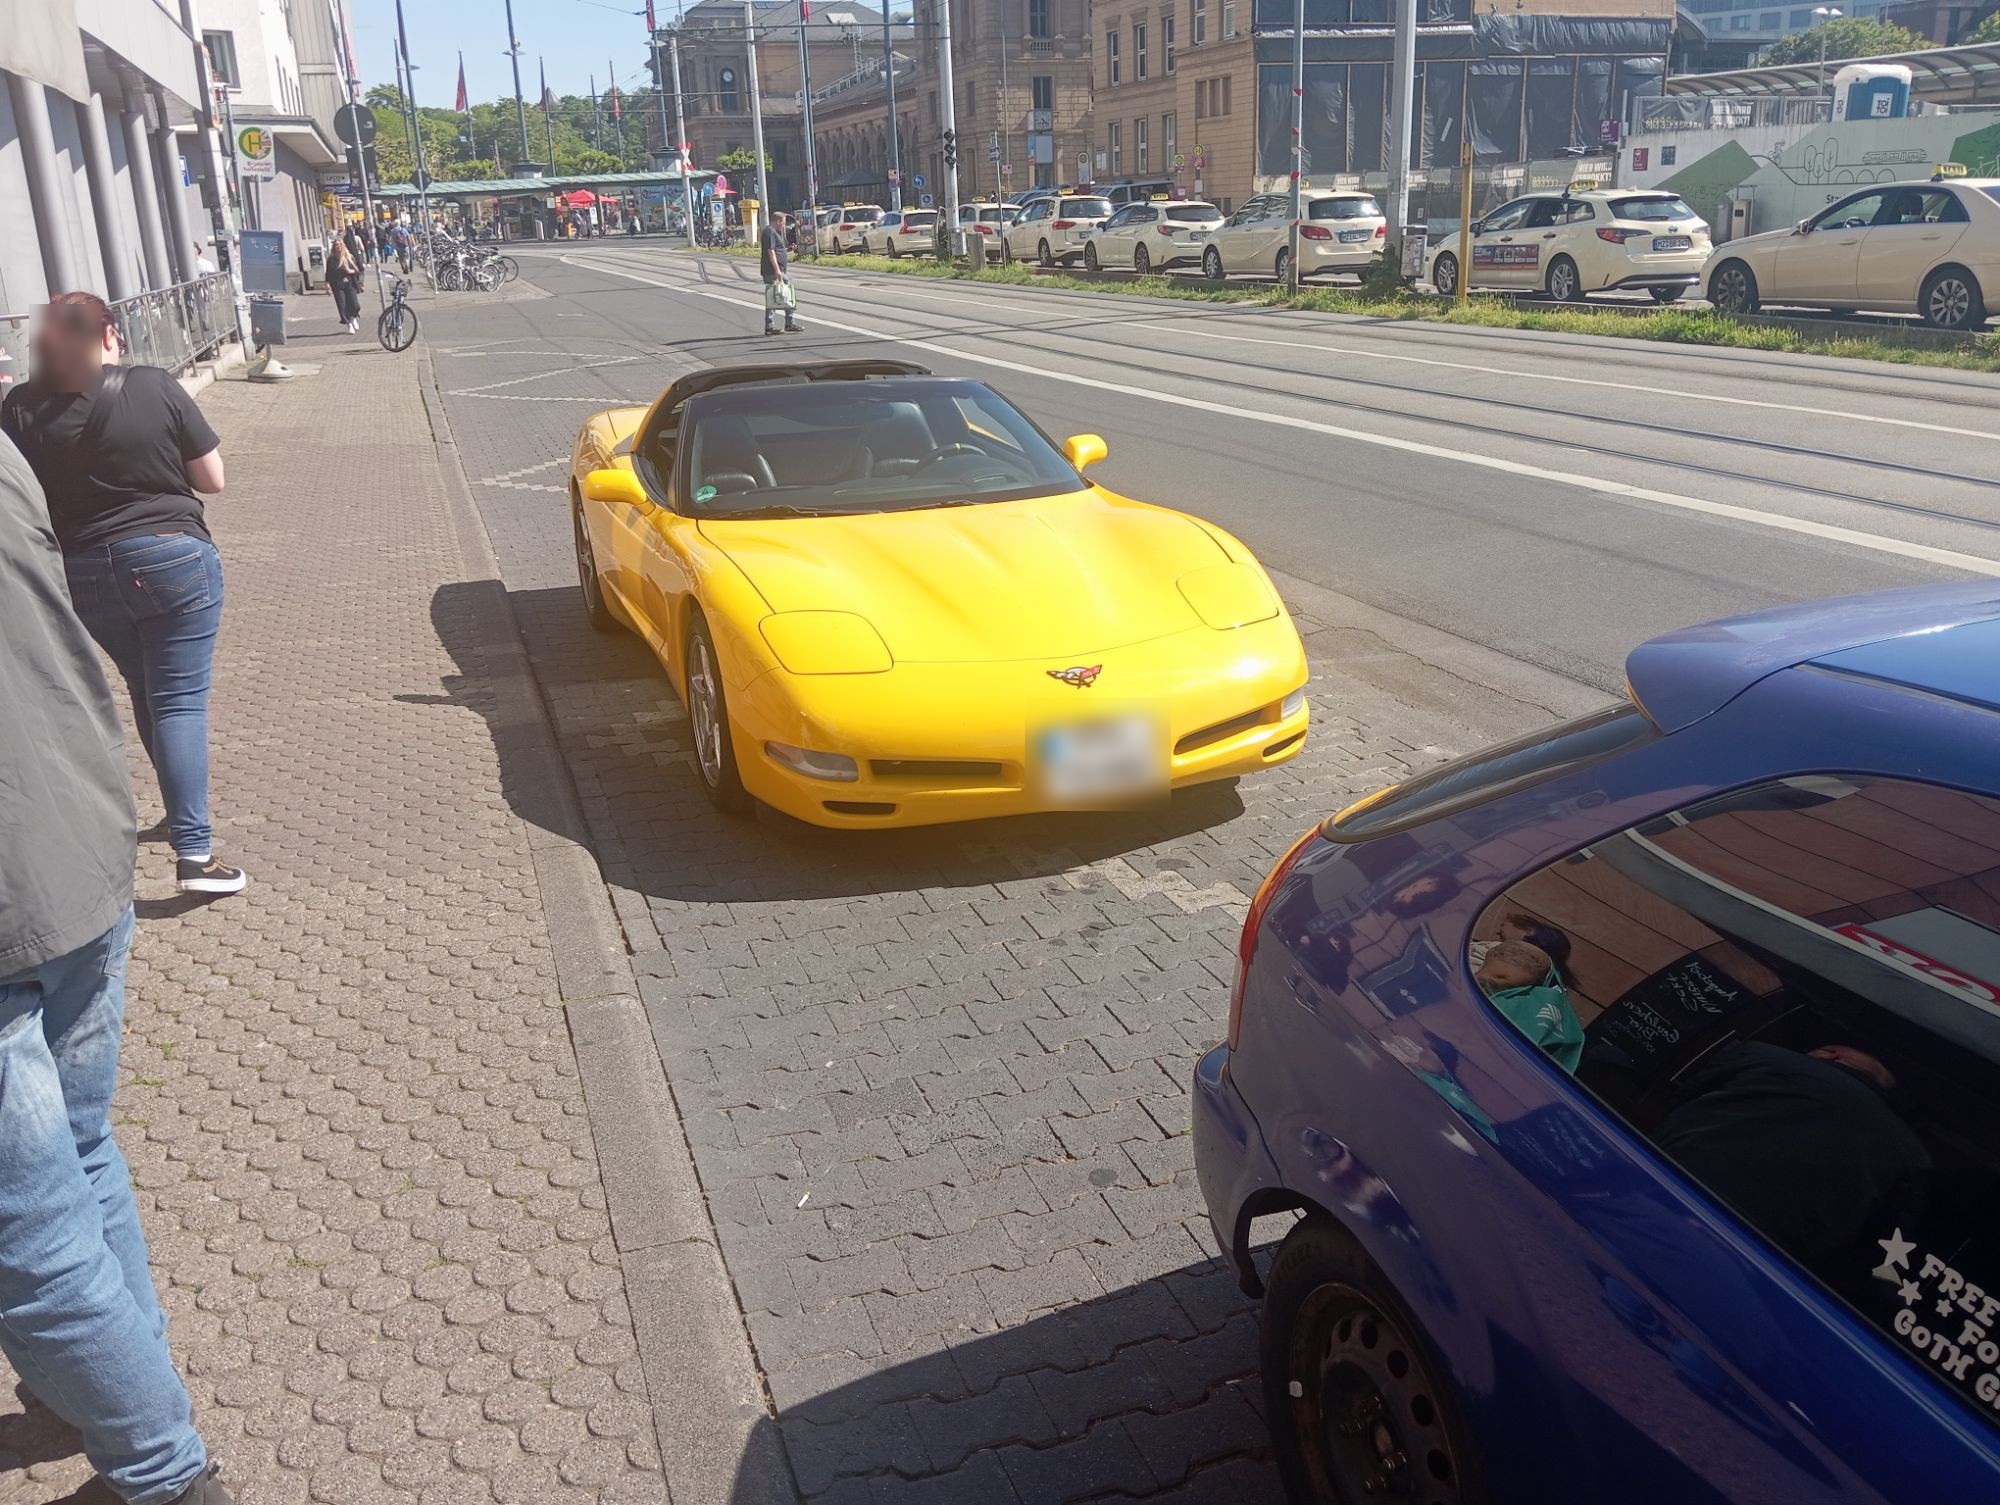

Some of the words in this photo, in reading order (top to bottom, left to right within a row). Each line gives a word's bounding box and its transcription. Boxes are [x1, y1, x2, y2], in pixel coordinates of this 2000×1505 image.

[1919, 1253, 2000, 1327] FREE
[1894, 1308, 1975, 1381] GOTH
[1957, 1319, 2000, 1374] FO
